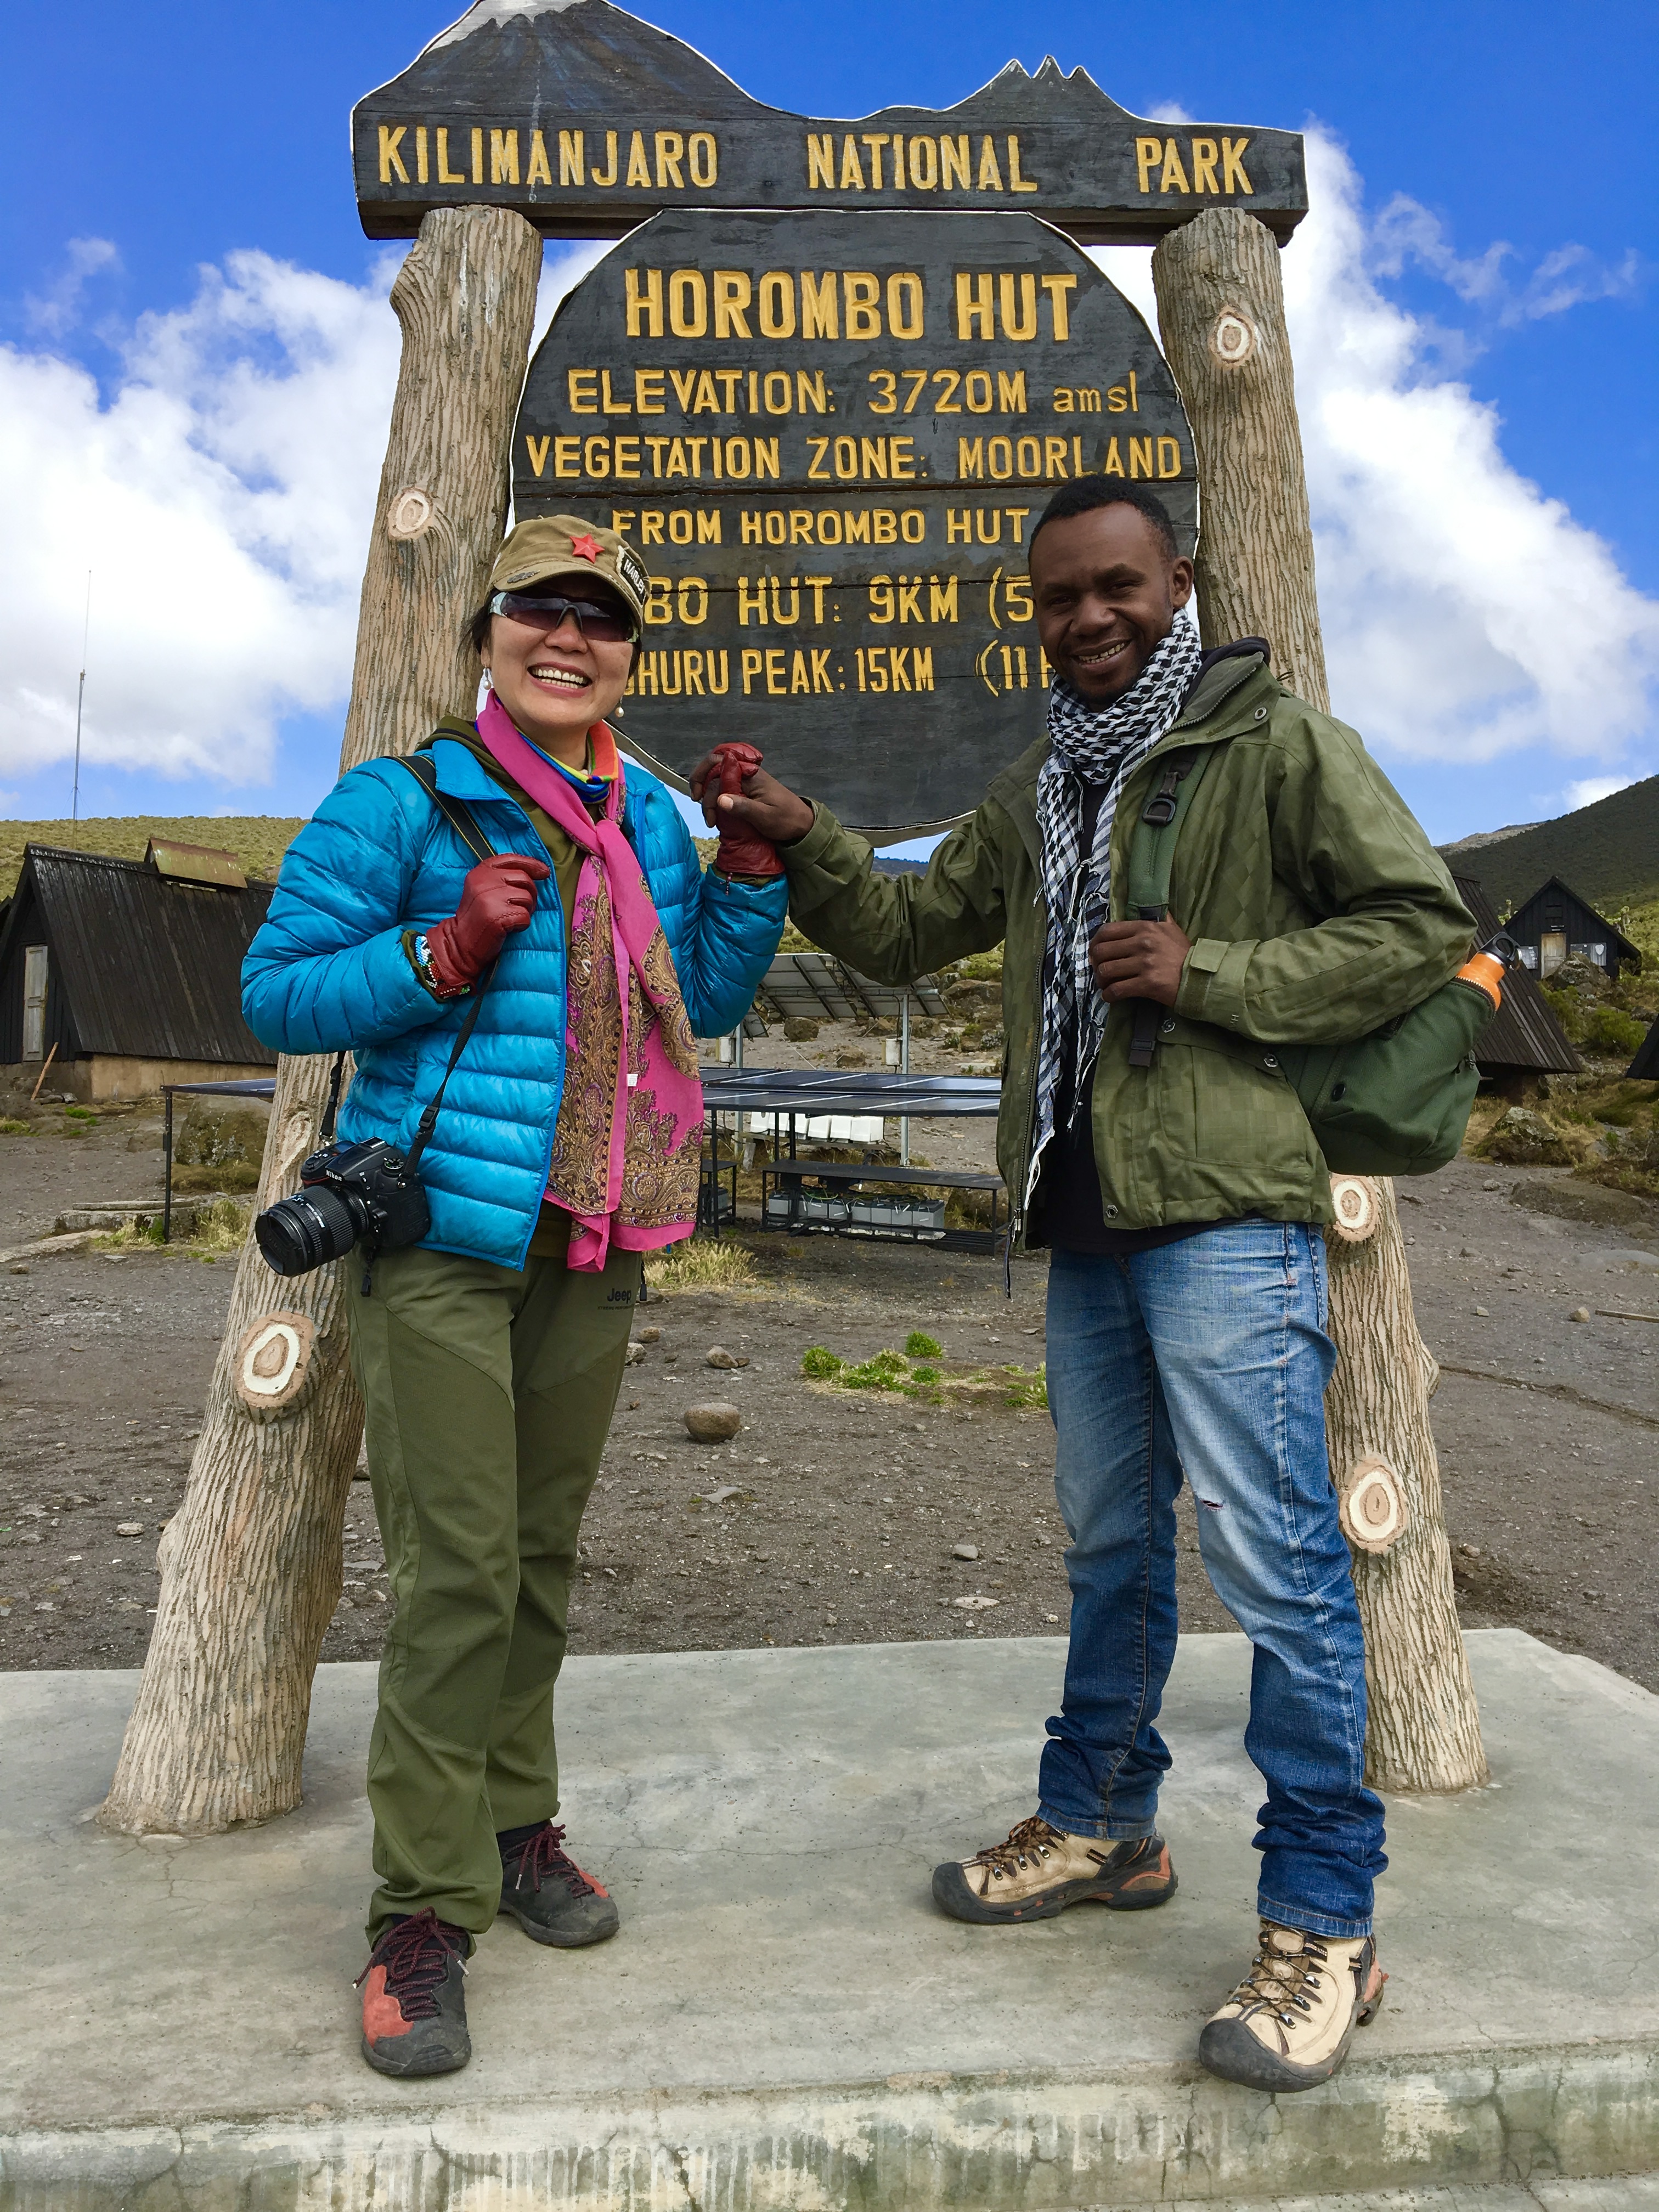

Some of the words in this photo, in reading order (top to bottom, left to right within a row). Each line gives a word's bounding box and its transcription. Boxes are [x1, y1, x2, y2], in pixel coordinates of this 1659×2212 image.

[379, 126, 718, 189] KILIMANJARO
[807, 133, 1037, 191] NATIONAL
[1136, 137, 1254, 194] PARK
[625, 268, 924, 340] HOROMBO
[956, 273, 1077, 341] HUT
[568, 369, 836, 415] ELEVATION:
[868, 369, 1028, 414] 3720M
[1053, 370, 1139, 413] amsl
[526, 436, 780, 479] VEGETATION
[806, 436, 928, 479] ZONE:
[959, 436, 1182, 479] MOORLAND
[612, 509, 721, 545] FROM
[741, 509, 926, 545] HOROMBO
[947, 508, 1030, 544] HUT
[644, 576, 708, 625] BO
[737, 575, 842, 625] HUT:
[868, 574, 958, 624] 9KM
[741, 648, 845, 695] PEAK:
[854, 646, 934, 692] 15KM
[326, 1169, 342, 1182] Nikon
[607, 1288, 632, 1305] Jeep
